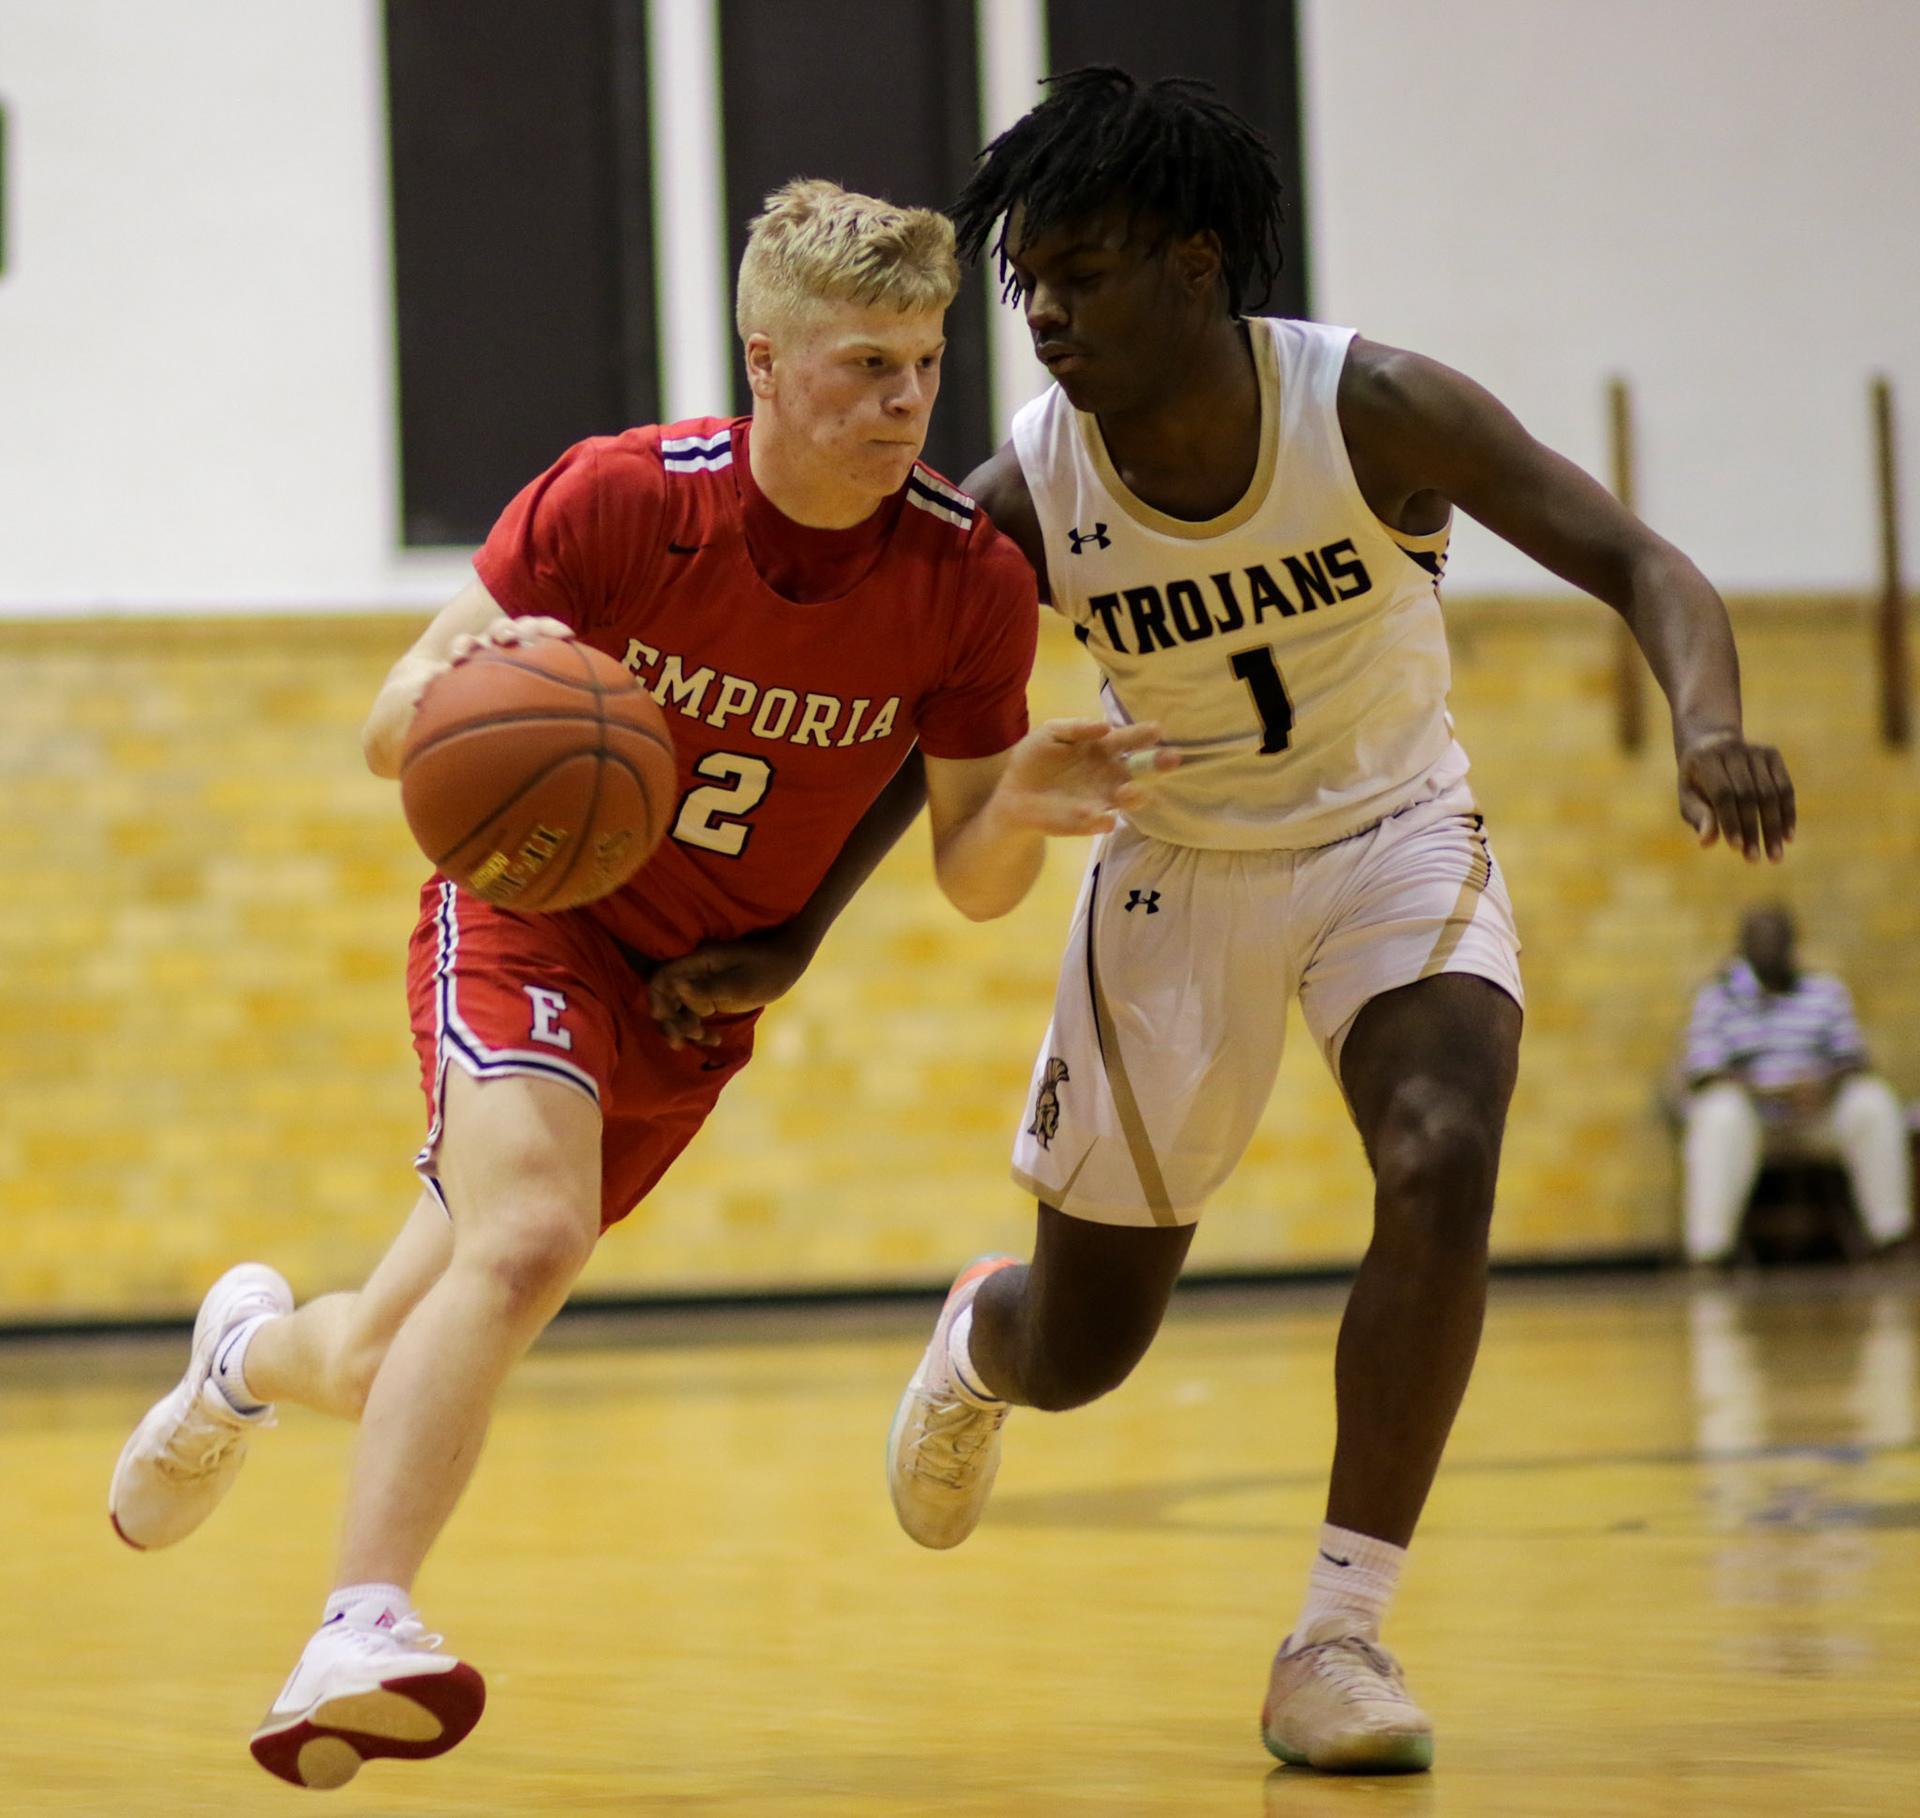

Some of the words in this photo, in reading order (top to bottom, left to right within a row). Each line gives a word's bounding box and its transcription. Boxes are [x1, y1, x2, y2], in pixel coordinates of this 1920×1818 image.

[1089, 538, 1372, 654] TROJANS
[622, 637, 901, 748] EMPORIA
[1226, 642, 1295, 758] 1
[667, 748, 776, 860] 2
[522, 984, 573, 1051] E
